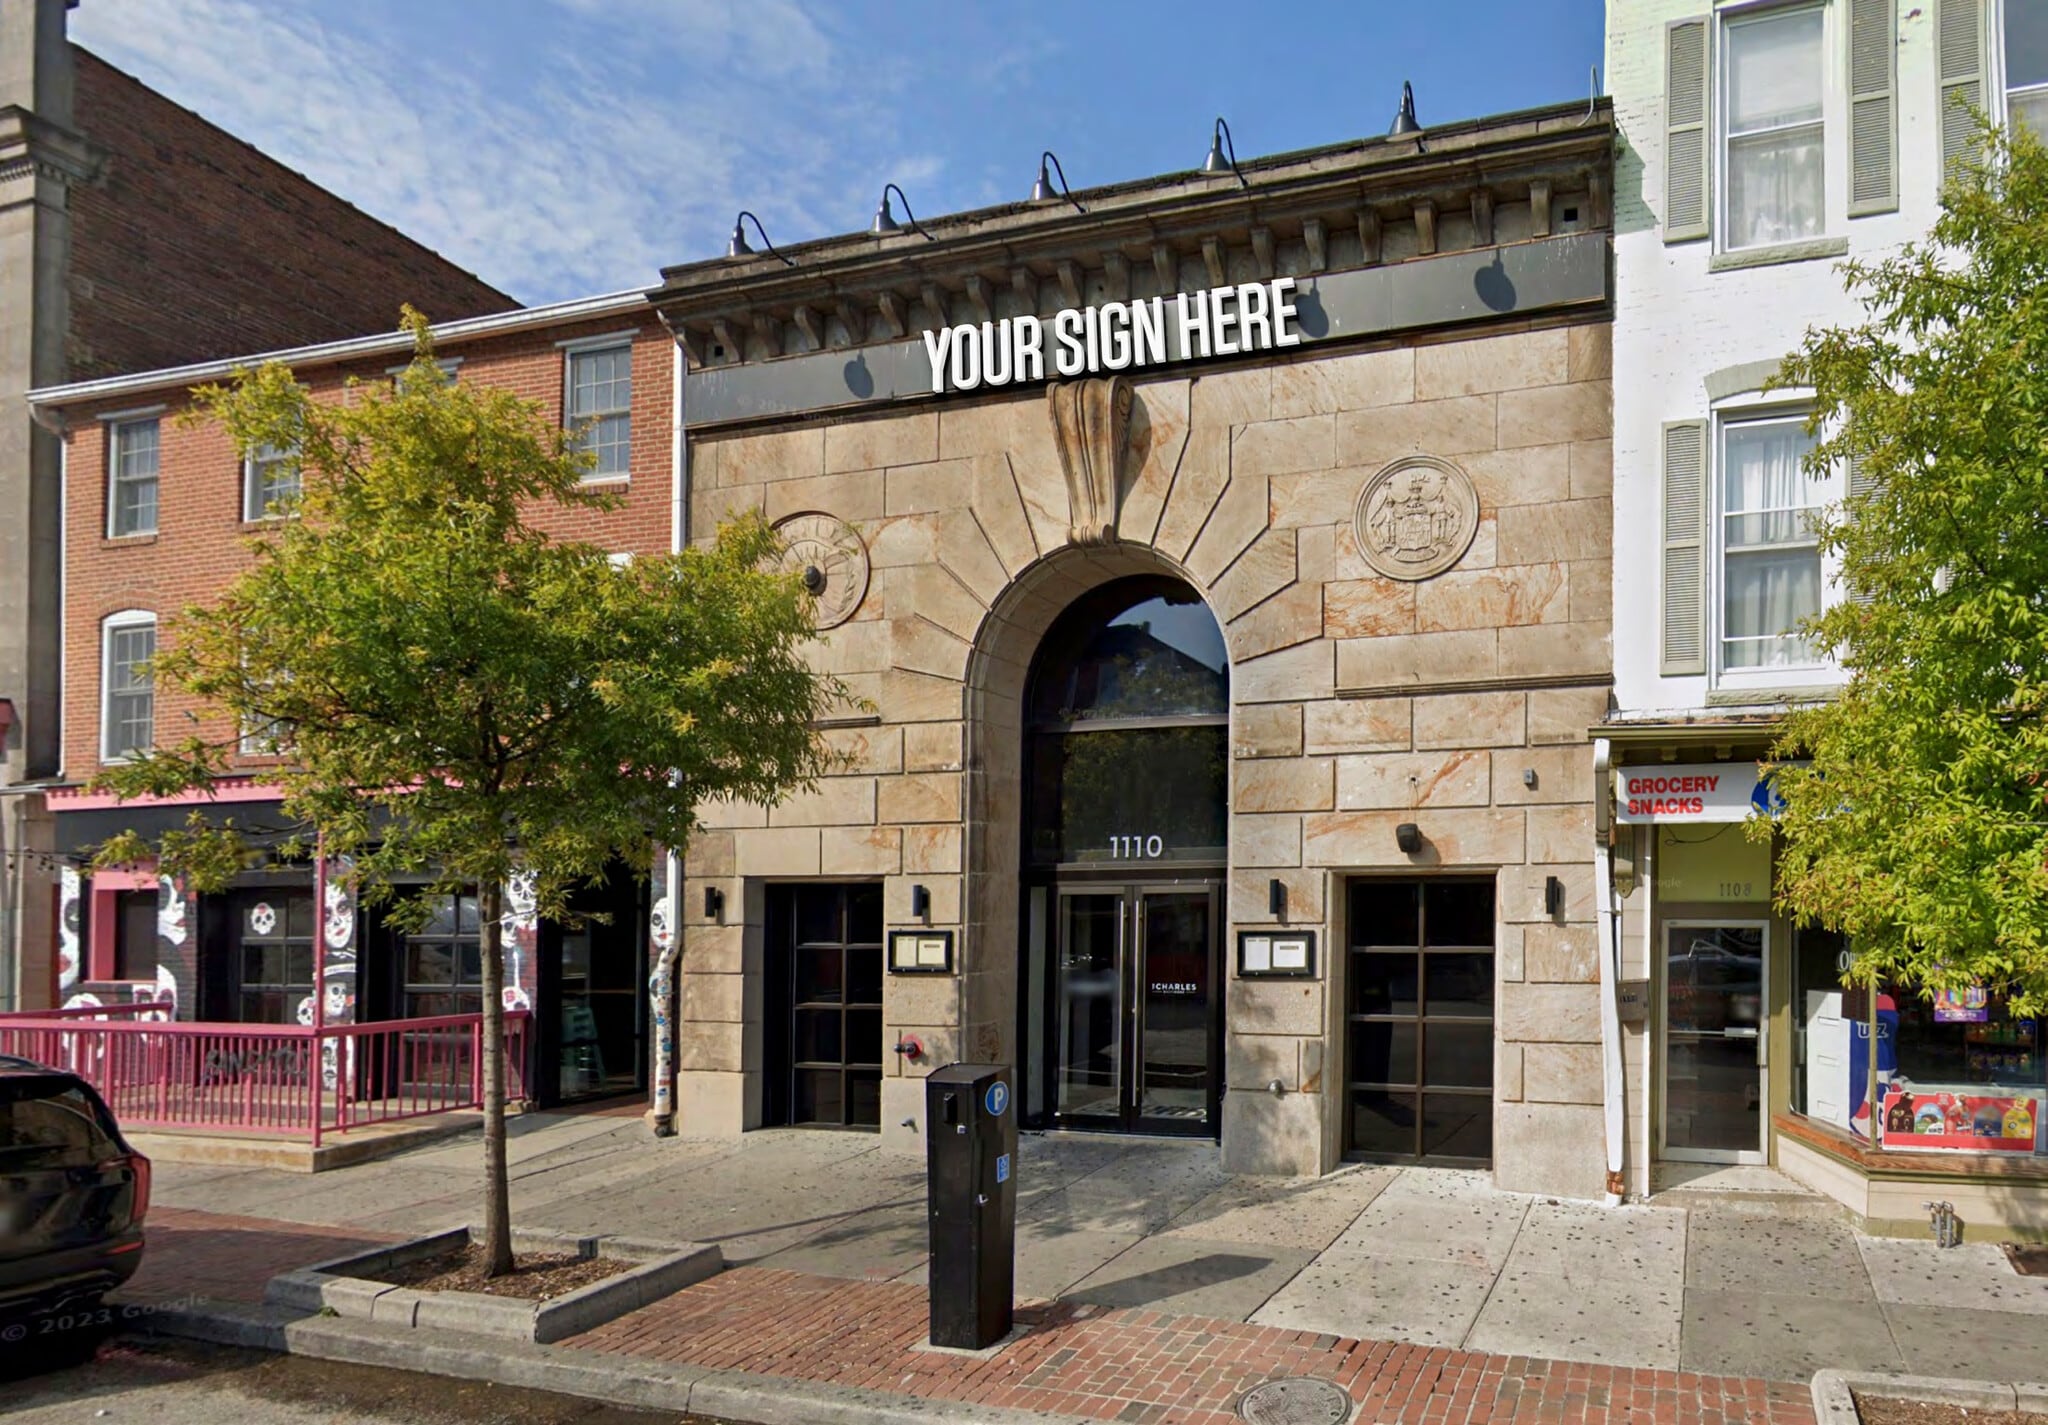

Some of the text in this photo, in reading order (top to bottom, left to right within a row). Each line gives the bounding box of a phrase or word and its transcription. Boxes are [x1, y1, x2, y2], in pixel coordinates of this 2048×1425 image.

[922, 277, 1301, 393] YOUR SIGN HERE
[1628, 775, 1719, 795] GROCERY
[1628, 797, 1704, 815] SNACKS
[1110, 835, 1163, 858] 1110
[1719, 882, 1752, 897] 1108
[1155, 983, 1197, 991] CHARLES
[993, 1086, 1004, 1111] P
